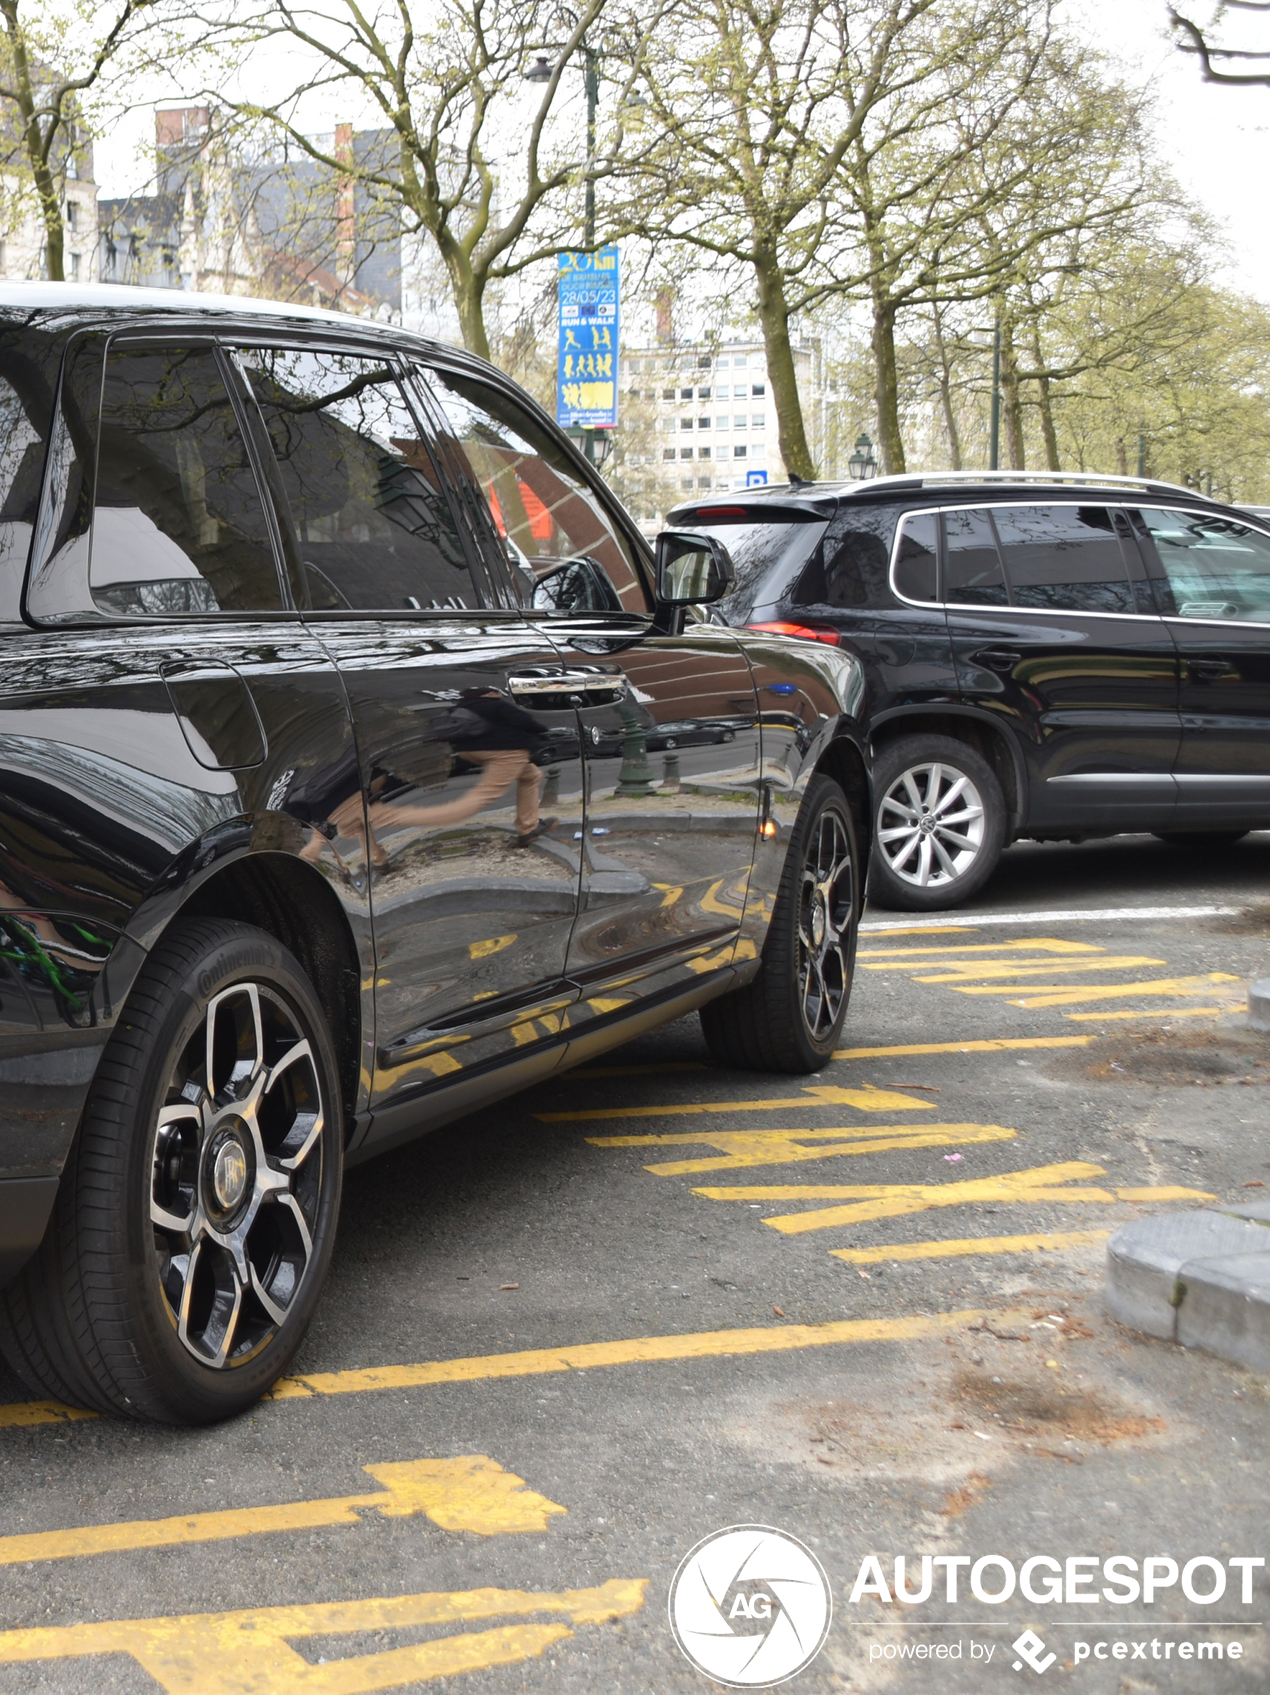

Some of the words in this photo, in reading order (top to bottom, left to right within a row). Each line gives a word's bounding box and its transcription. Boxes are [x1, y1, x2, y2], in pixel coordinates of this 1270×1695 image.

[562, 289, 616, 305] 28/05/23
[561, 318, 580, 327] RUN
[588, 316, 615, 325] WALK
